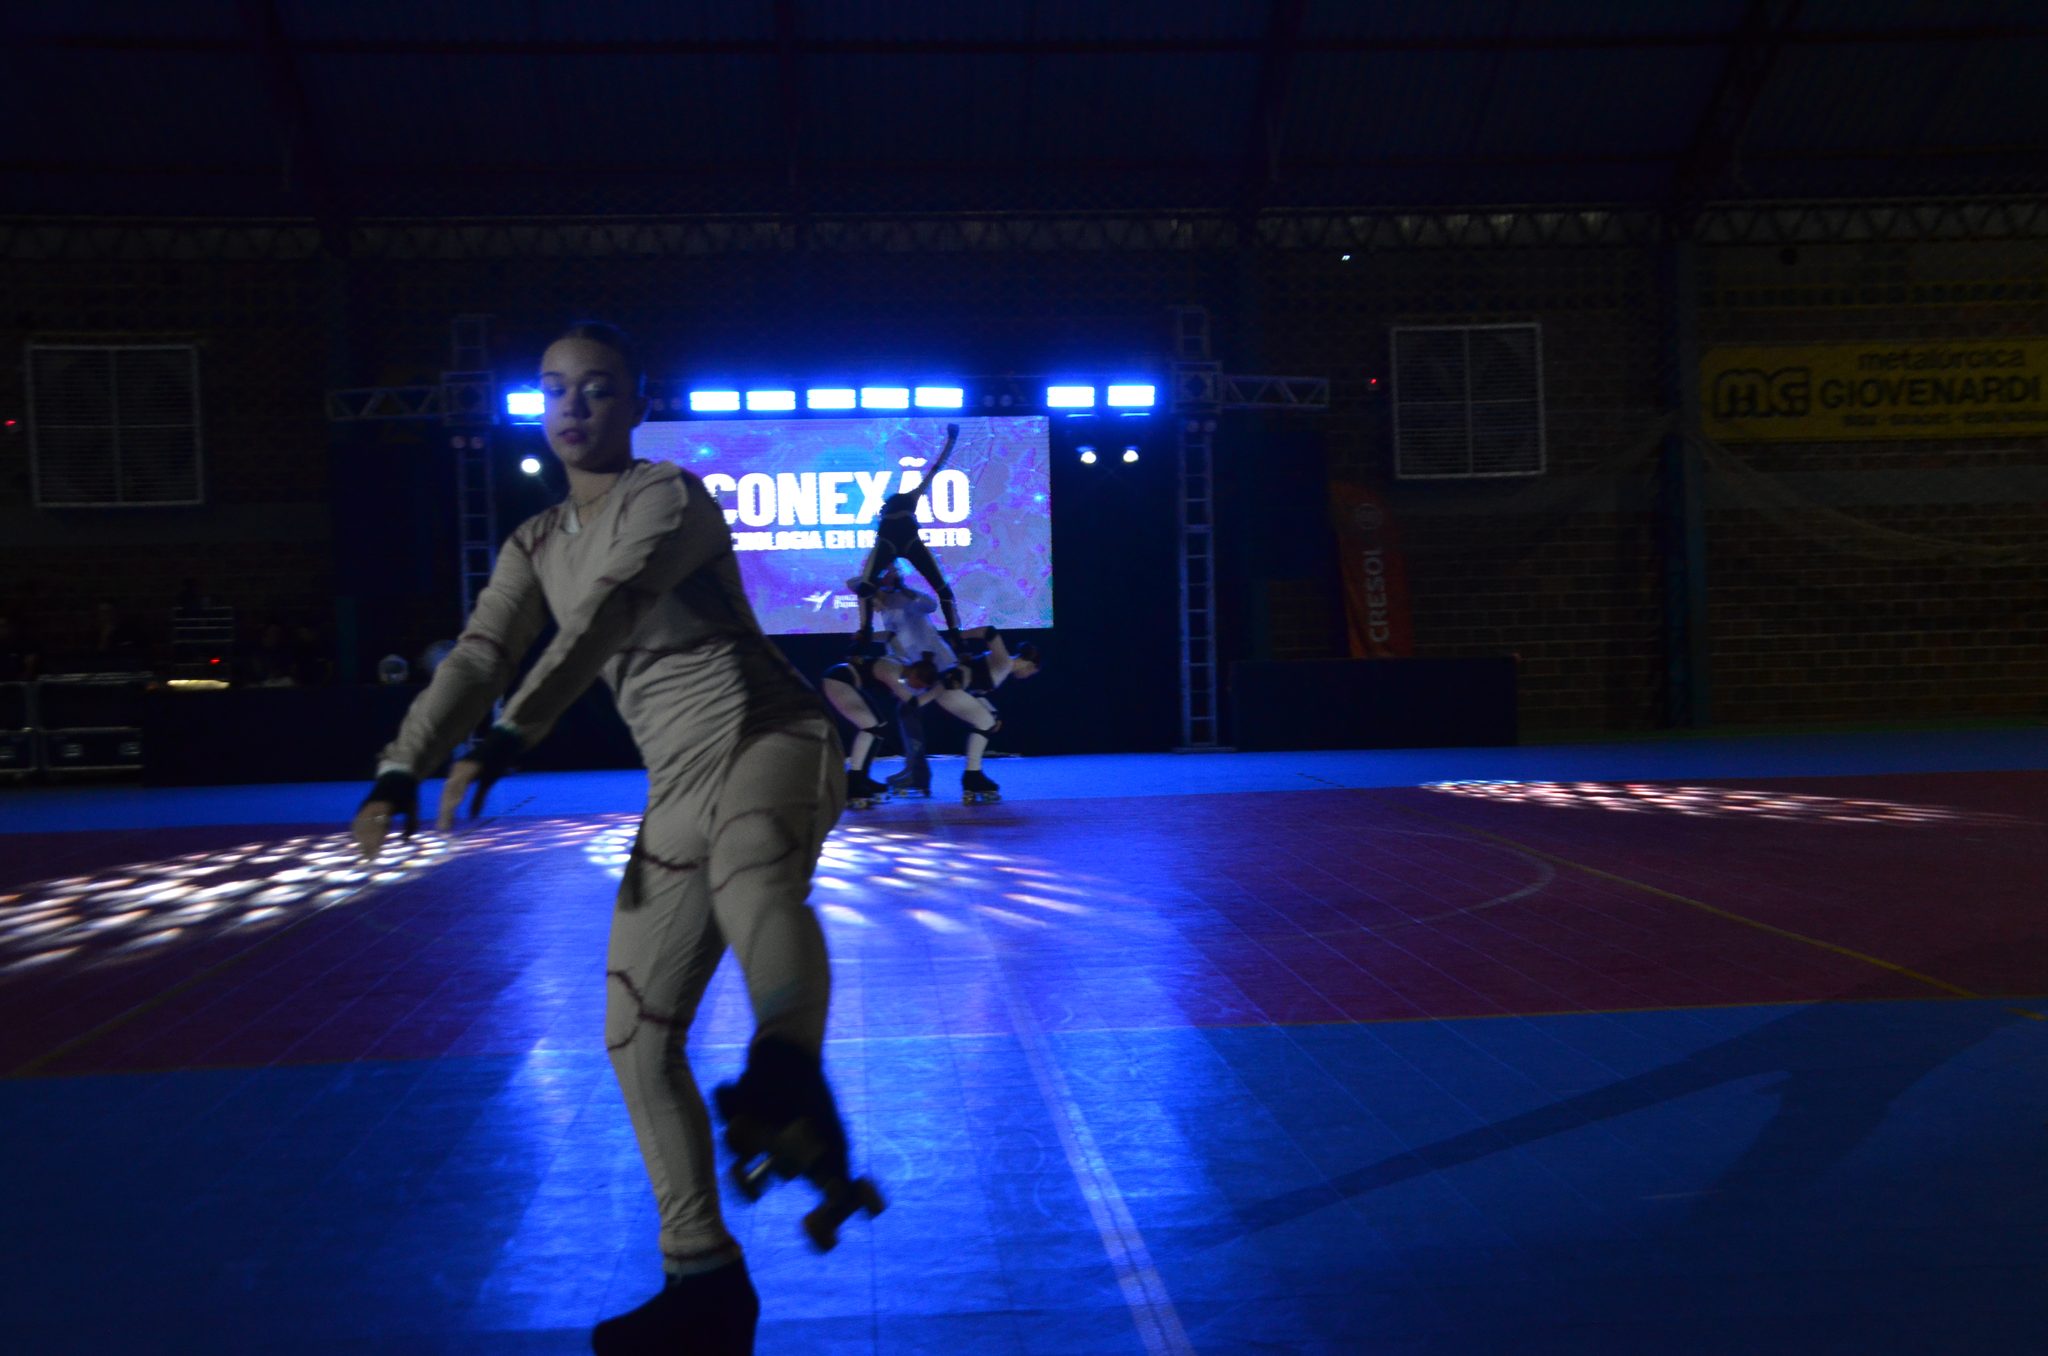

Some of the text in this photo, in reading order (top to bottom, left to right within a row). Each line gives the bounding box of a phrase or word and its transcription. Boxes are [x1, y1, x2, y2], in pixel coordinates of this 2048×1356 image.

[1820, 375, 2040, 408] GIOVENARDI
[703, 456, 971, 527] CONEXÃO
[1363, 546, 1390, 643] CRESOL
